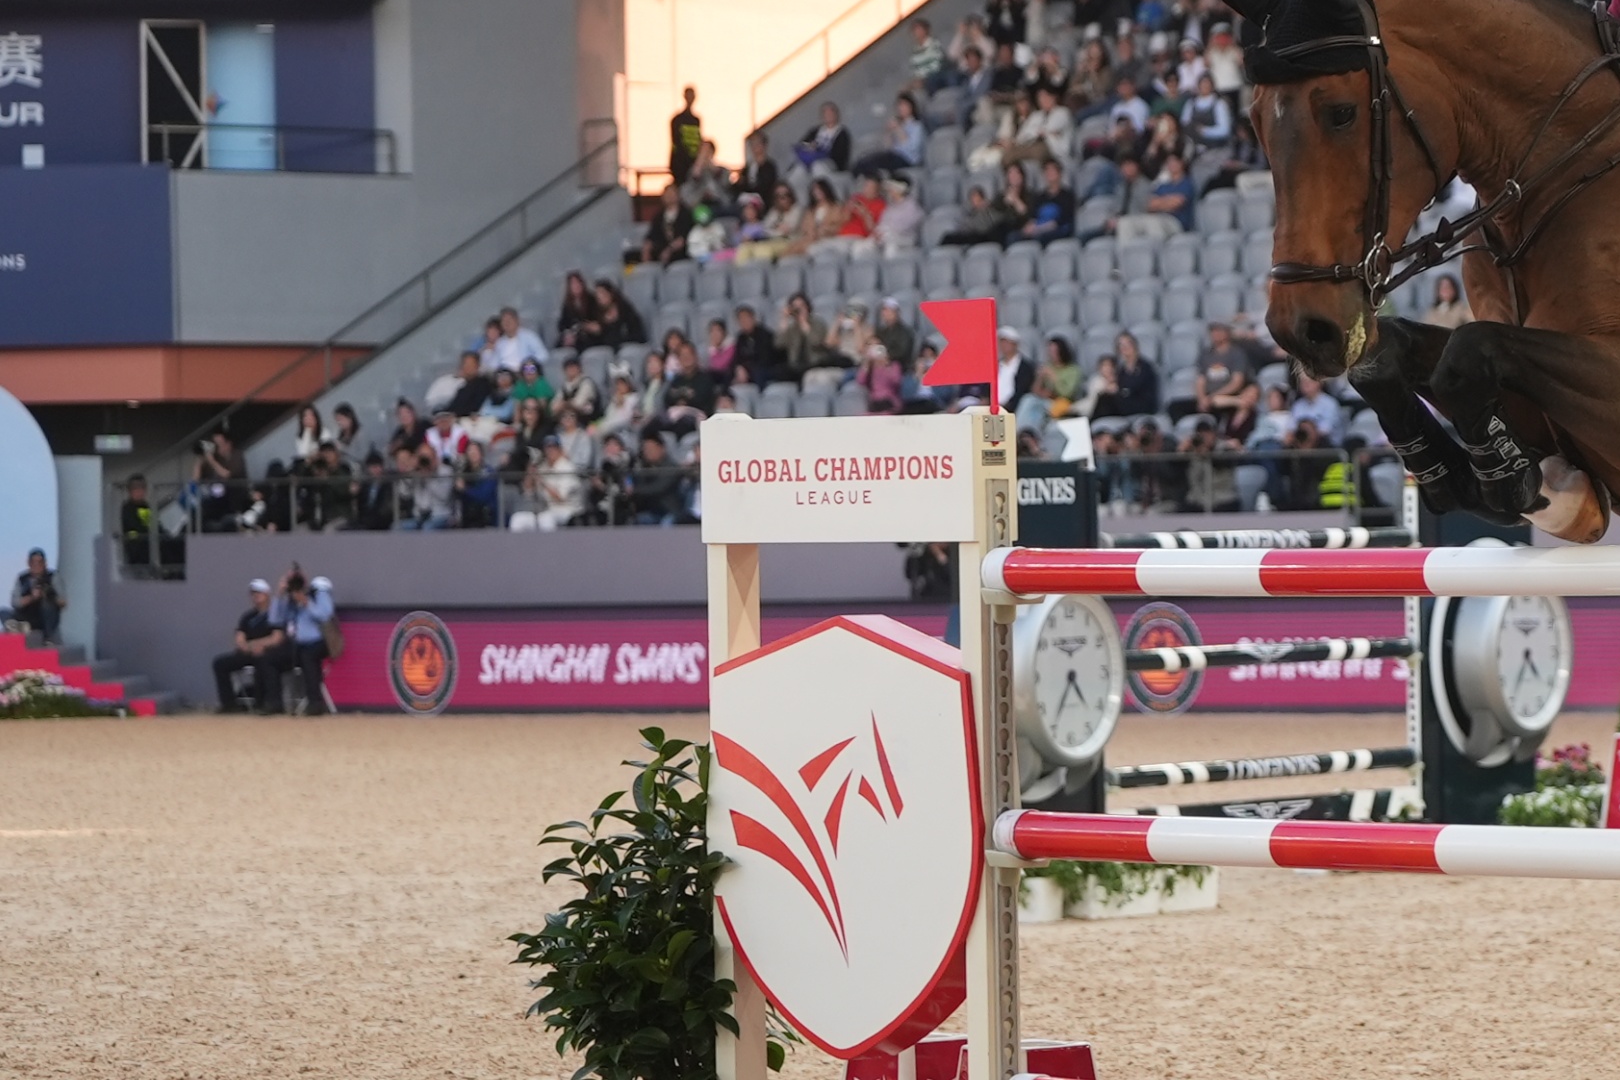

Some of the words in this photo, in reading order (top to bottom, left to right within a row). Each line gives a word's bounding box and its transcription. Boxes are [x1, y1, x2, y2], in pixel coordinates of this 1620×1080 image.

[0, 253, 26, 271] NS
[718, 458, 806, 483] GLOBAL
[814, 455, 954, 481] CHAMPIONS
[796, 490, 872, 505] LEAGUE
[1017, 476, 1076, 505] GINES
[478, 644, 610, 684] SHANGHAI
[614, 643, 706, 684] SWANS
